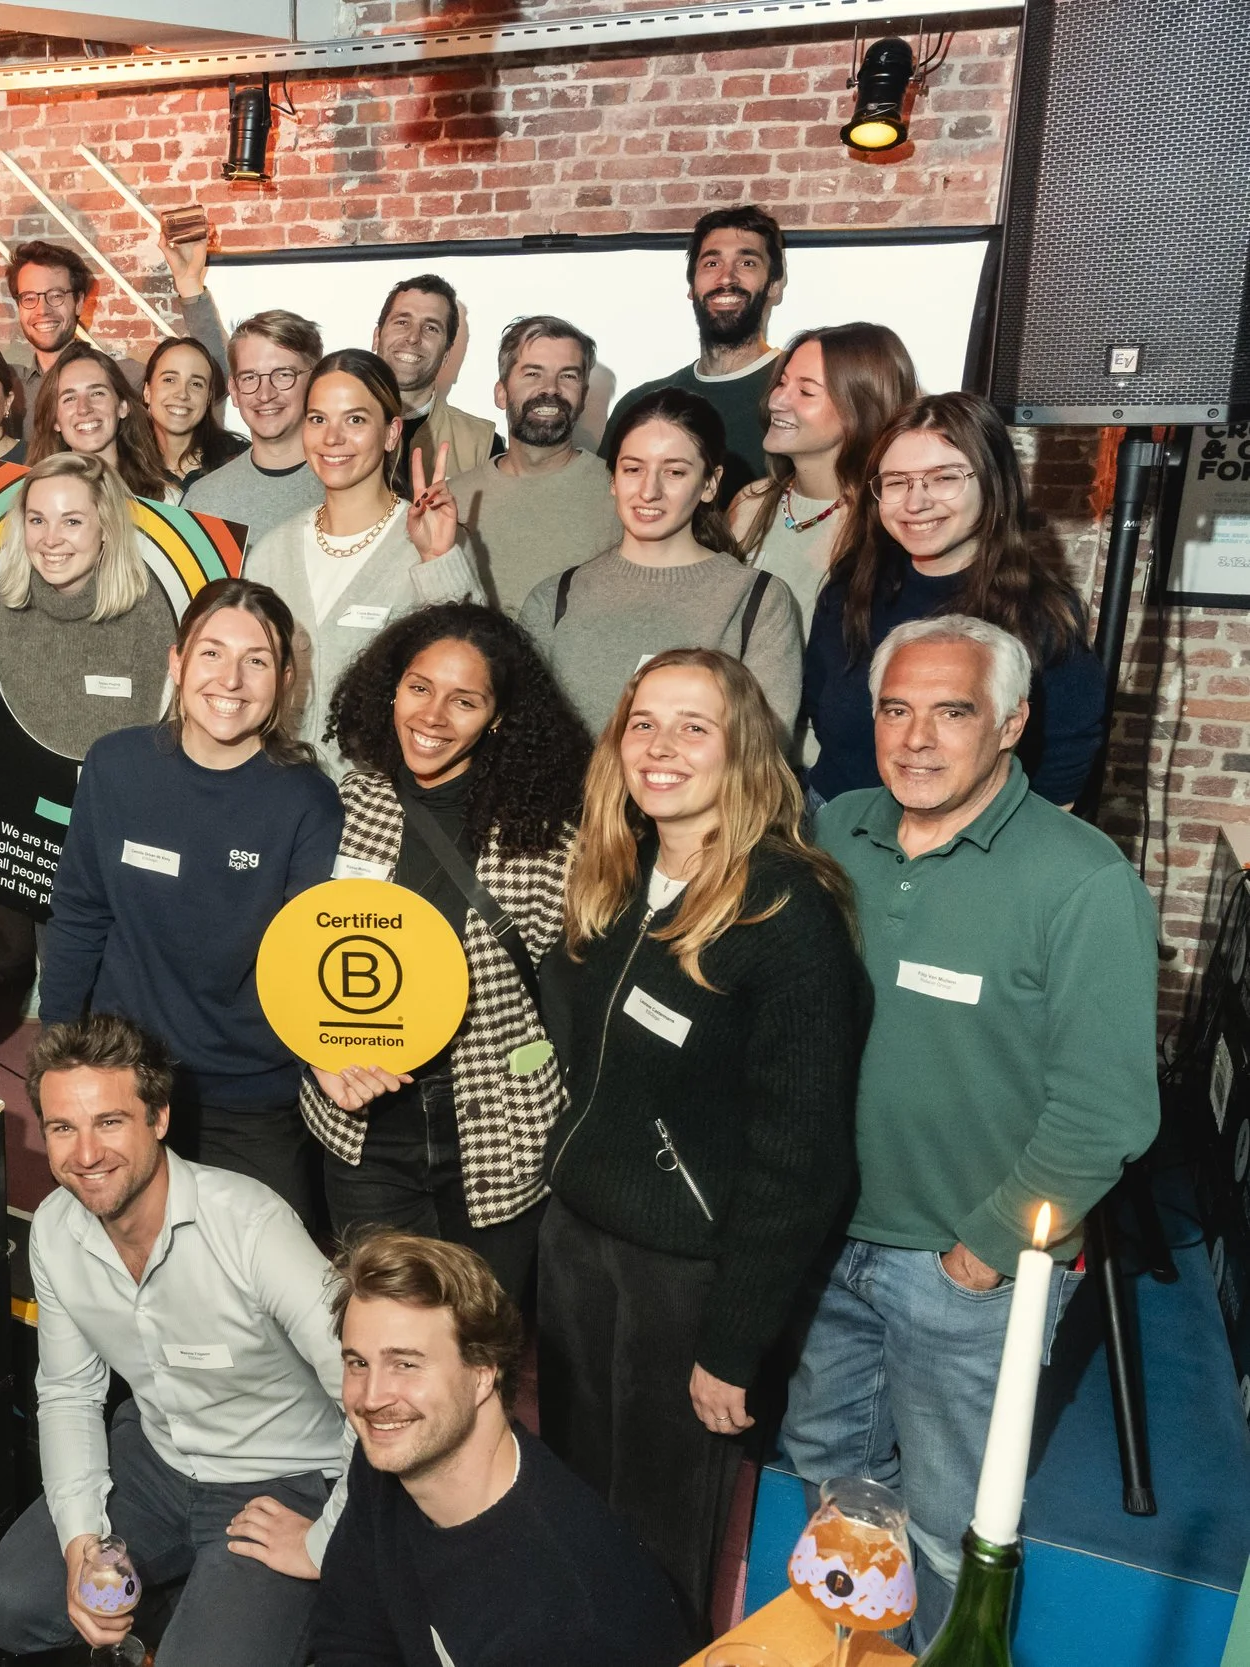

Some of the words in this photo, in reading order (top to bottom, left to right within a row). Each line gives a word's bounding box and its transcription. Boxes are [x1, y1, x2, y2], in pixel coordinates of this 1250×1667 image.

[1, 821, 20, 839] We
[22, 833, 41, 847] are
[228, 858, 248, 870] logic
[229, 849, 260, 868] esg
[18, 882, 37, 898] the
[316, 911, 403, 929] Certified
[319, 1032, 404, 1048] Corporation
